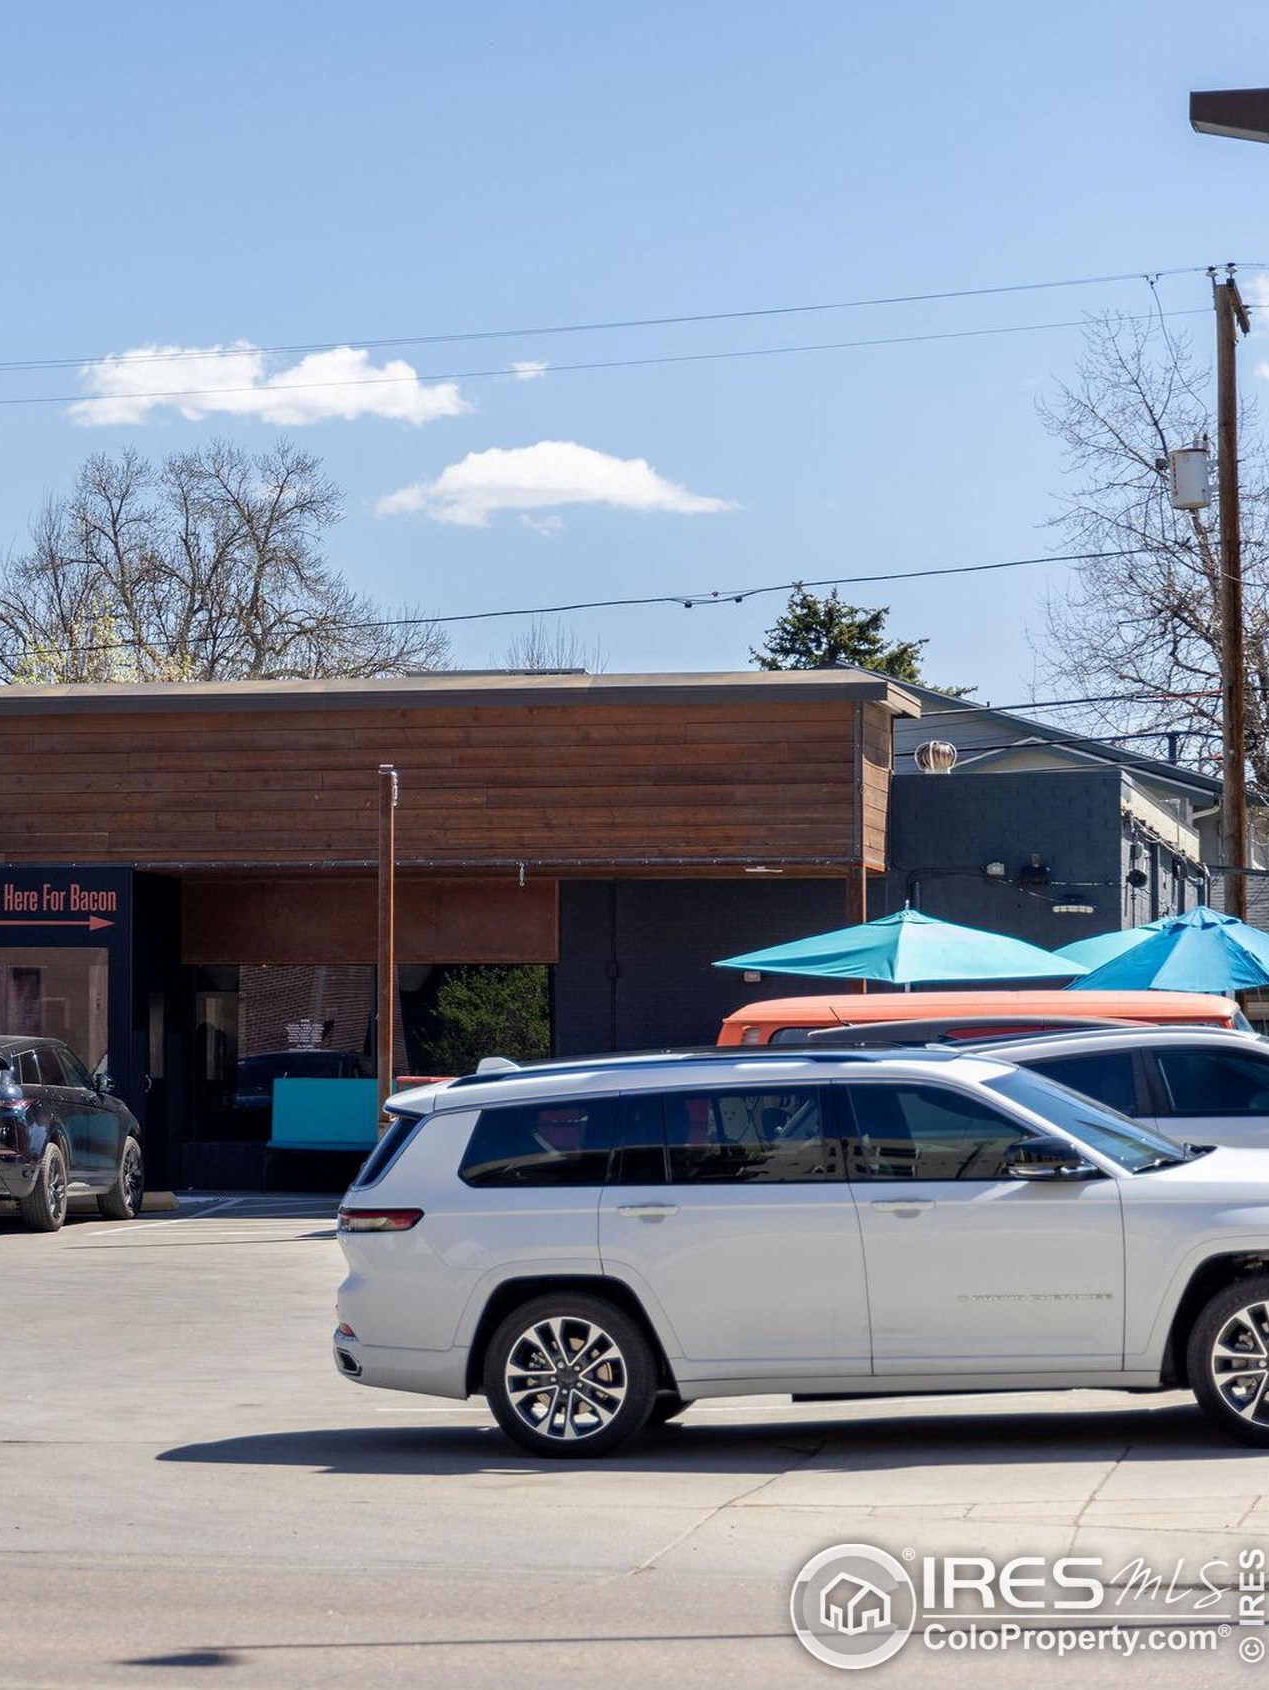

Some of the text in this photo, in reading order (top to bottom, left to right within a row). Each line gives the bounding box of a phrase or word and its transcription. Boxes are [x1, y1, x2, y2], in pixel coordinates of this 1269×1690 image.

[4, 884, 38, 911] Here
[43, 884, 66, 911] For
[70, 884, 116, 911] Bacon
